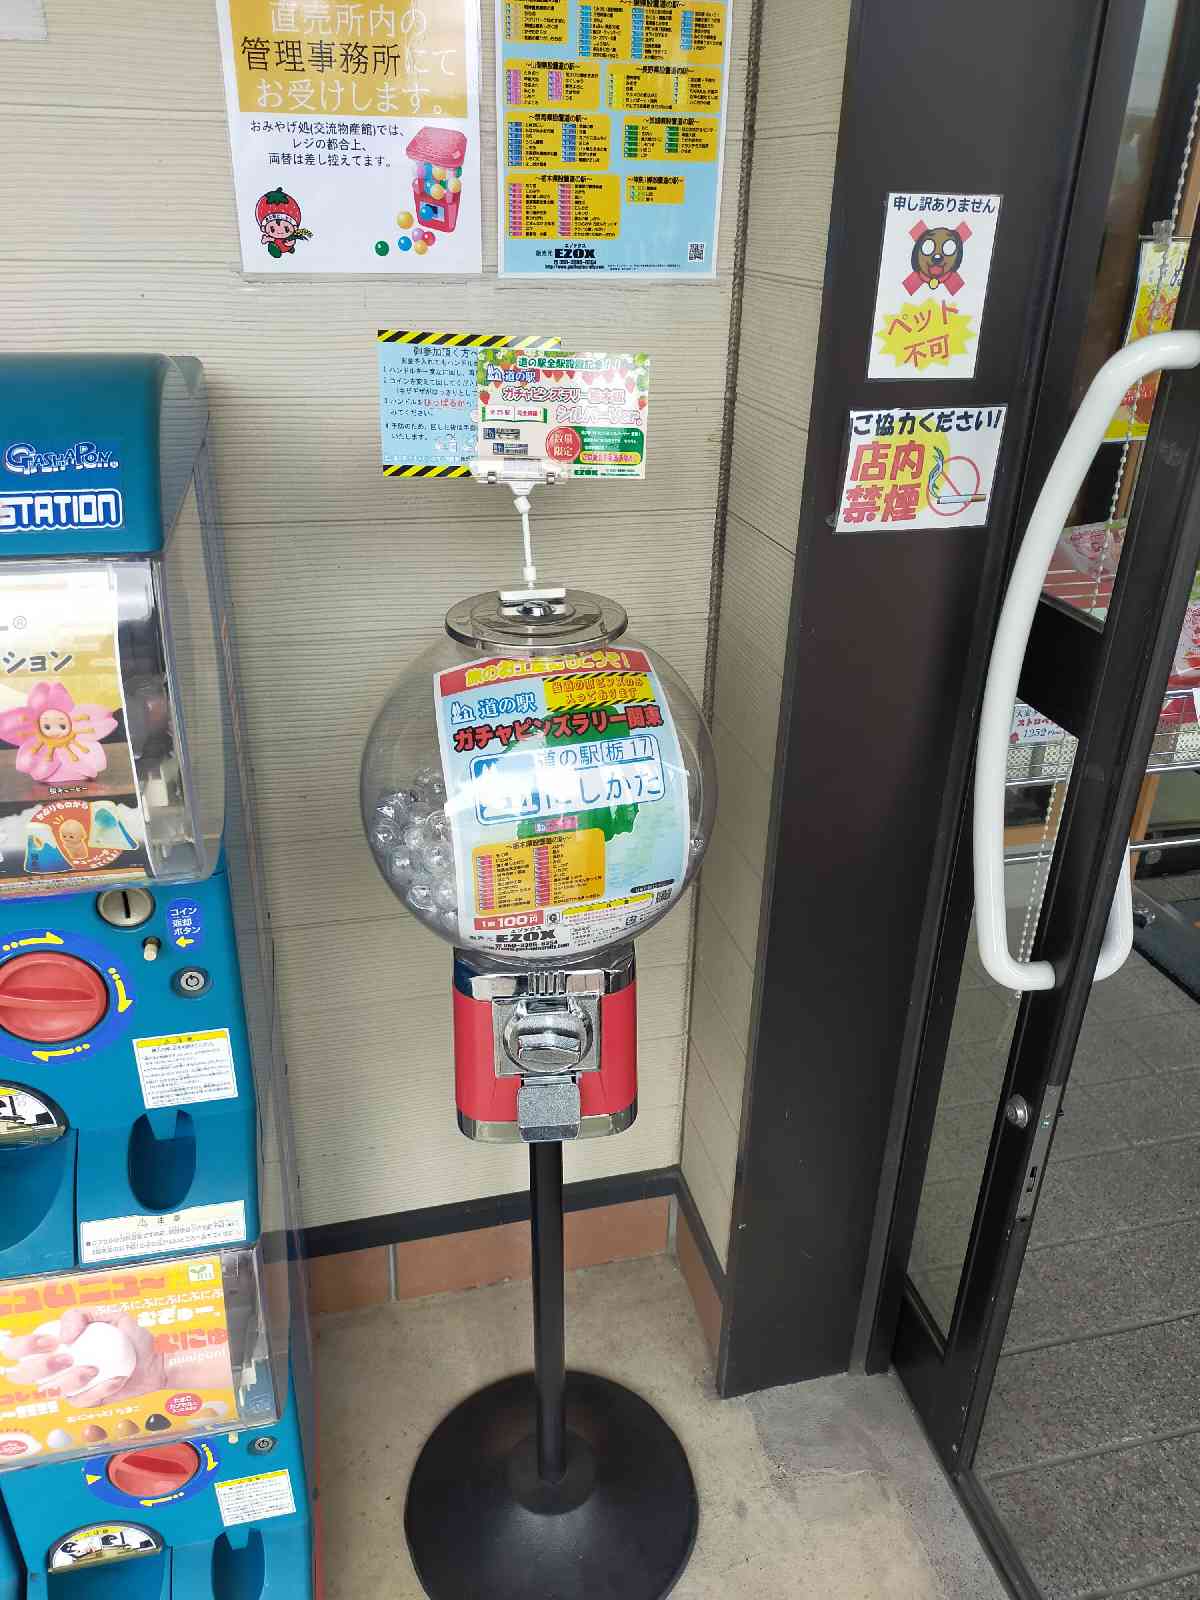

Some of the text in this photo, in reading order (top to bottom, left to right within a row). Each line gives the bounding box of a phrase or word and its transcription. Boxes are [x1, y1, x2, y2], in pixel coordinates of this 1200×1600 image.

[270, 1, 428, 38] 直売所内の
[241, 36, 457, 77] 管理事務所にて
[257, 79, 443, 116] お受けします。
[292, 137, 368, 152] レジの都合上、
[268, 152, 392, 168] 両替は差し控えてます。
[893, 196, 996, 214] 申し訳ありません
[554, 248, 596, 259] EZOX
[887, 300, 960, 336] ペット
[903, 334, 950, 368] 不可
[503, 369, 537, 383] 道の駅
[850, 440, 926, 482] 店内
[842, 482, 922, 524] 禁煙
[478, 691, 538, 721] 道の駅
[170, 906, 198, 917] コイン
[172, 917, 193, 928] 返却
[173, 925, 201, 936] ボタン
[495, 929, 556, 944] EZOX
